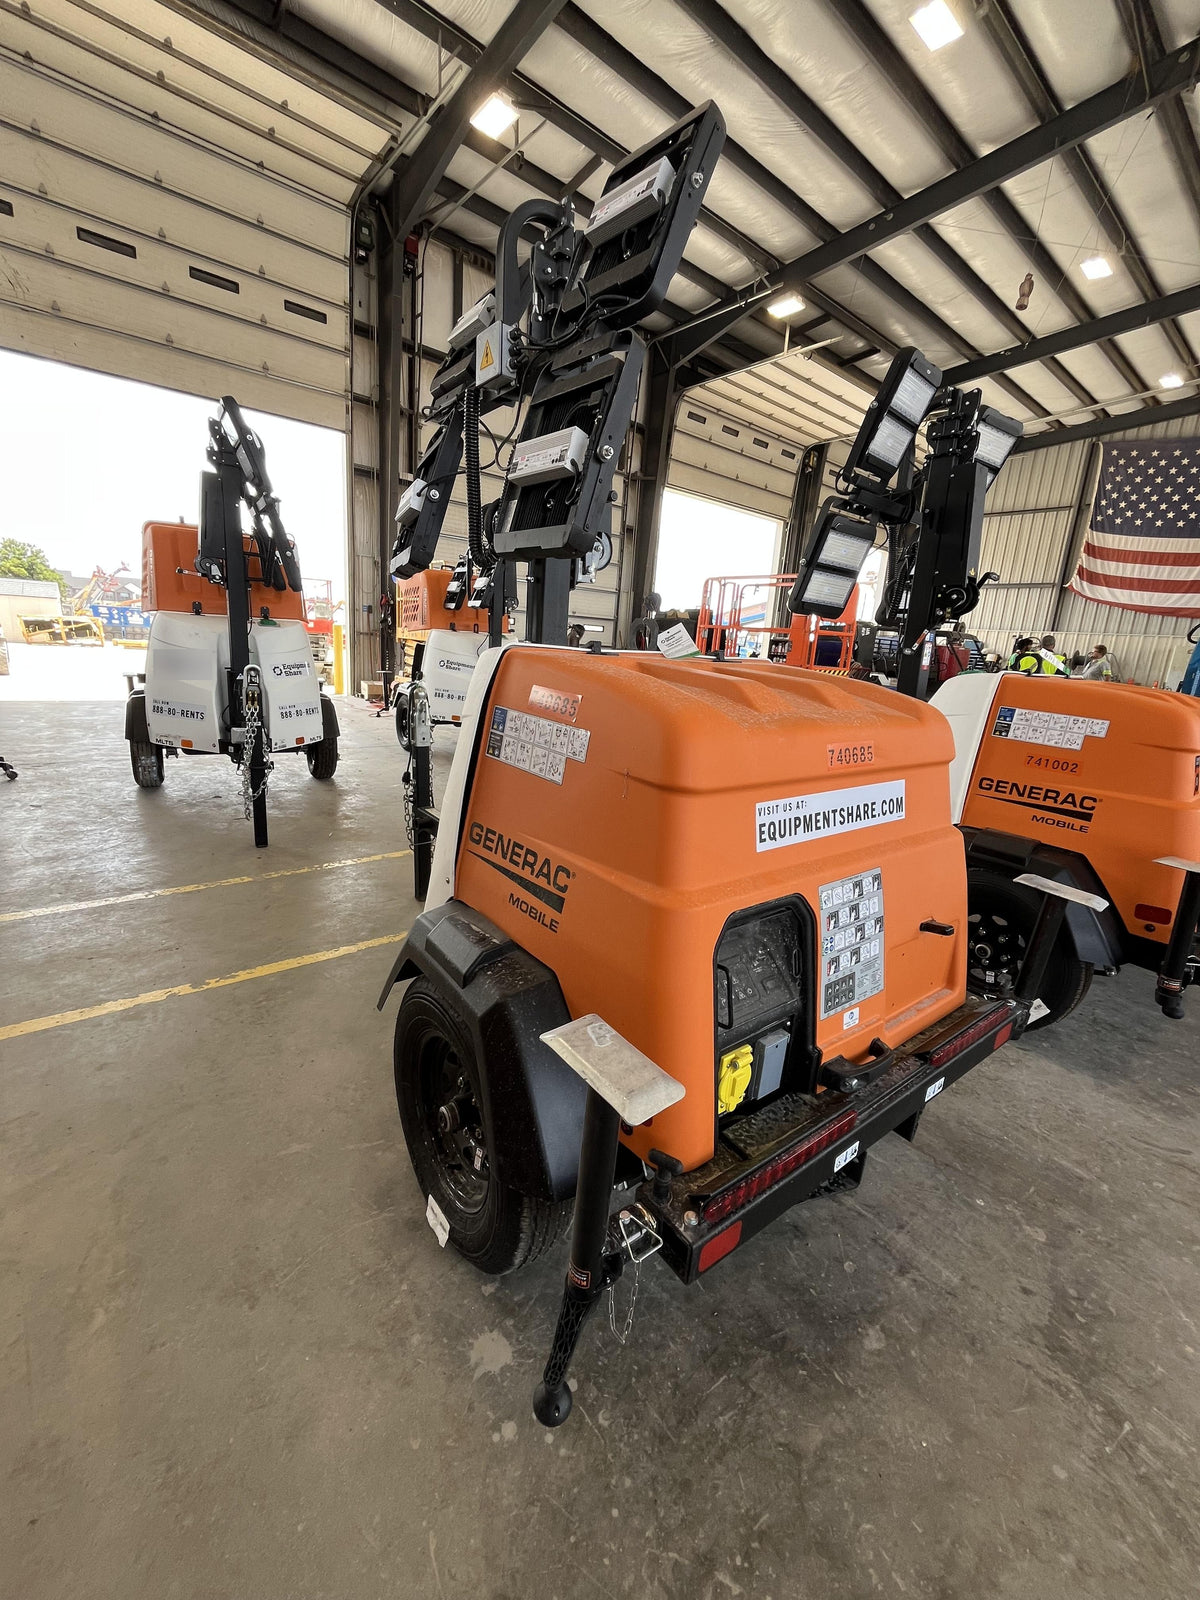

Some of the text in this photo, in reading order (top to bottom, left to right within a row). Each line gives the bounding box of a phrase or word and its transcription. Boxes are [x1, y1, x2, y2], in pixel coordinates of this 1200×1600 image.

[284, 668, 302, 677] Share
[434, 692, 467, 701] 888-80-RE
[152, 705, 205, 720] 888-80-RENTS
[280, 707, 319, 719] 888-80-RENTS
[828, 745, 873, 766] 740685
[1026, 755, 1079, 773] 741002
[978, 776, 1097, 811] GENERAC
[758, 800, 807, 817] VISIT US AT:
[758, 796, 904, 843] EQUIPMENTSHARE.COM
[1031, 814, 1090, 834] MOBILE
[469, 821, 571, 894] GENERAC
[508, 892, 559, 934] MOBILE
